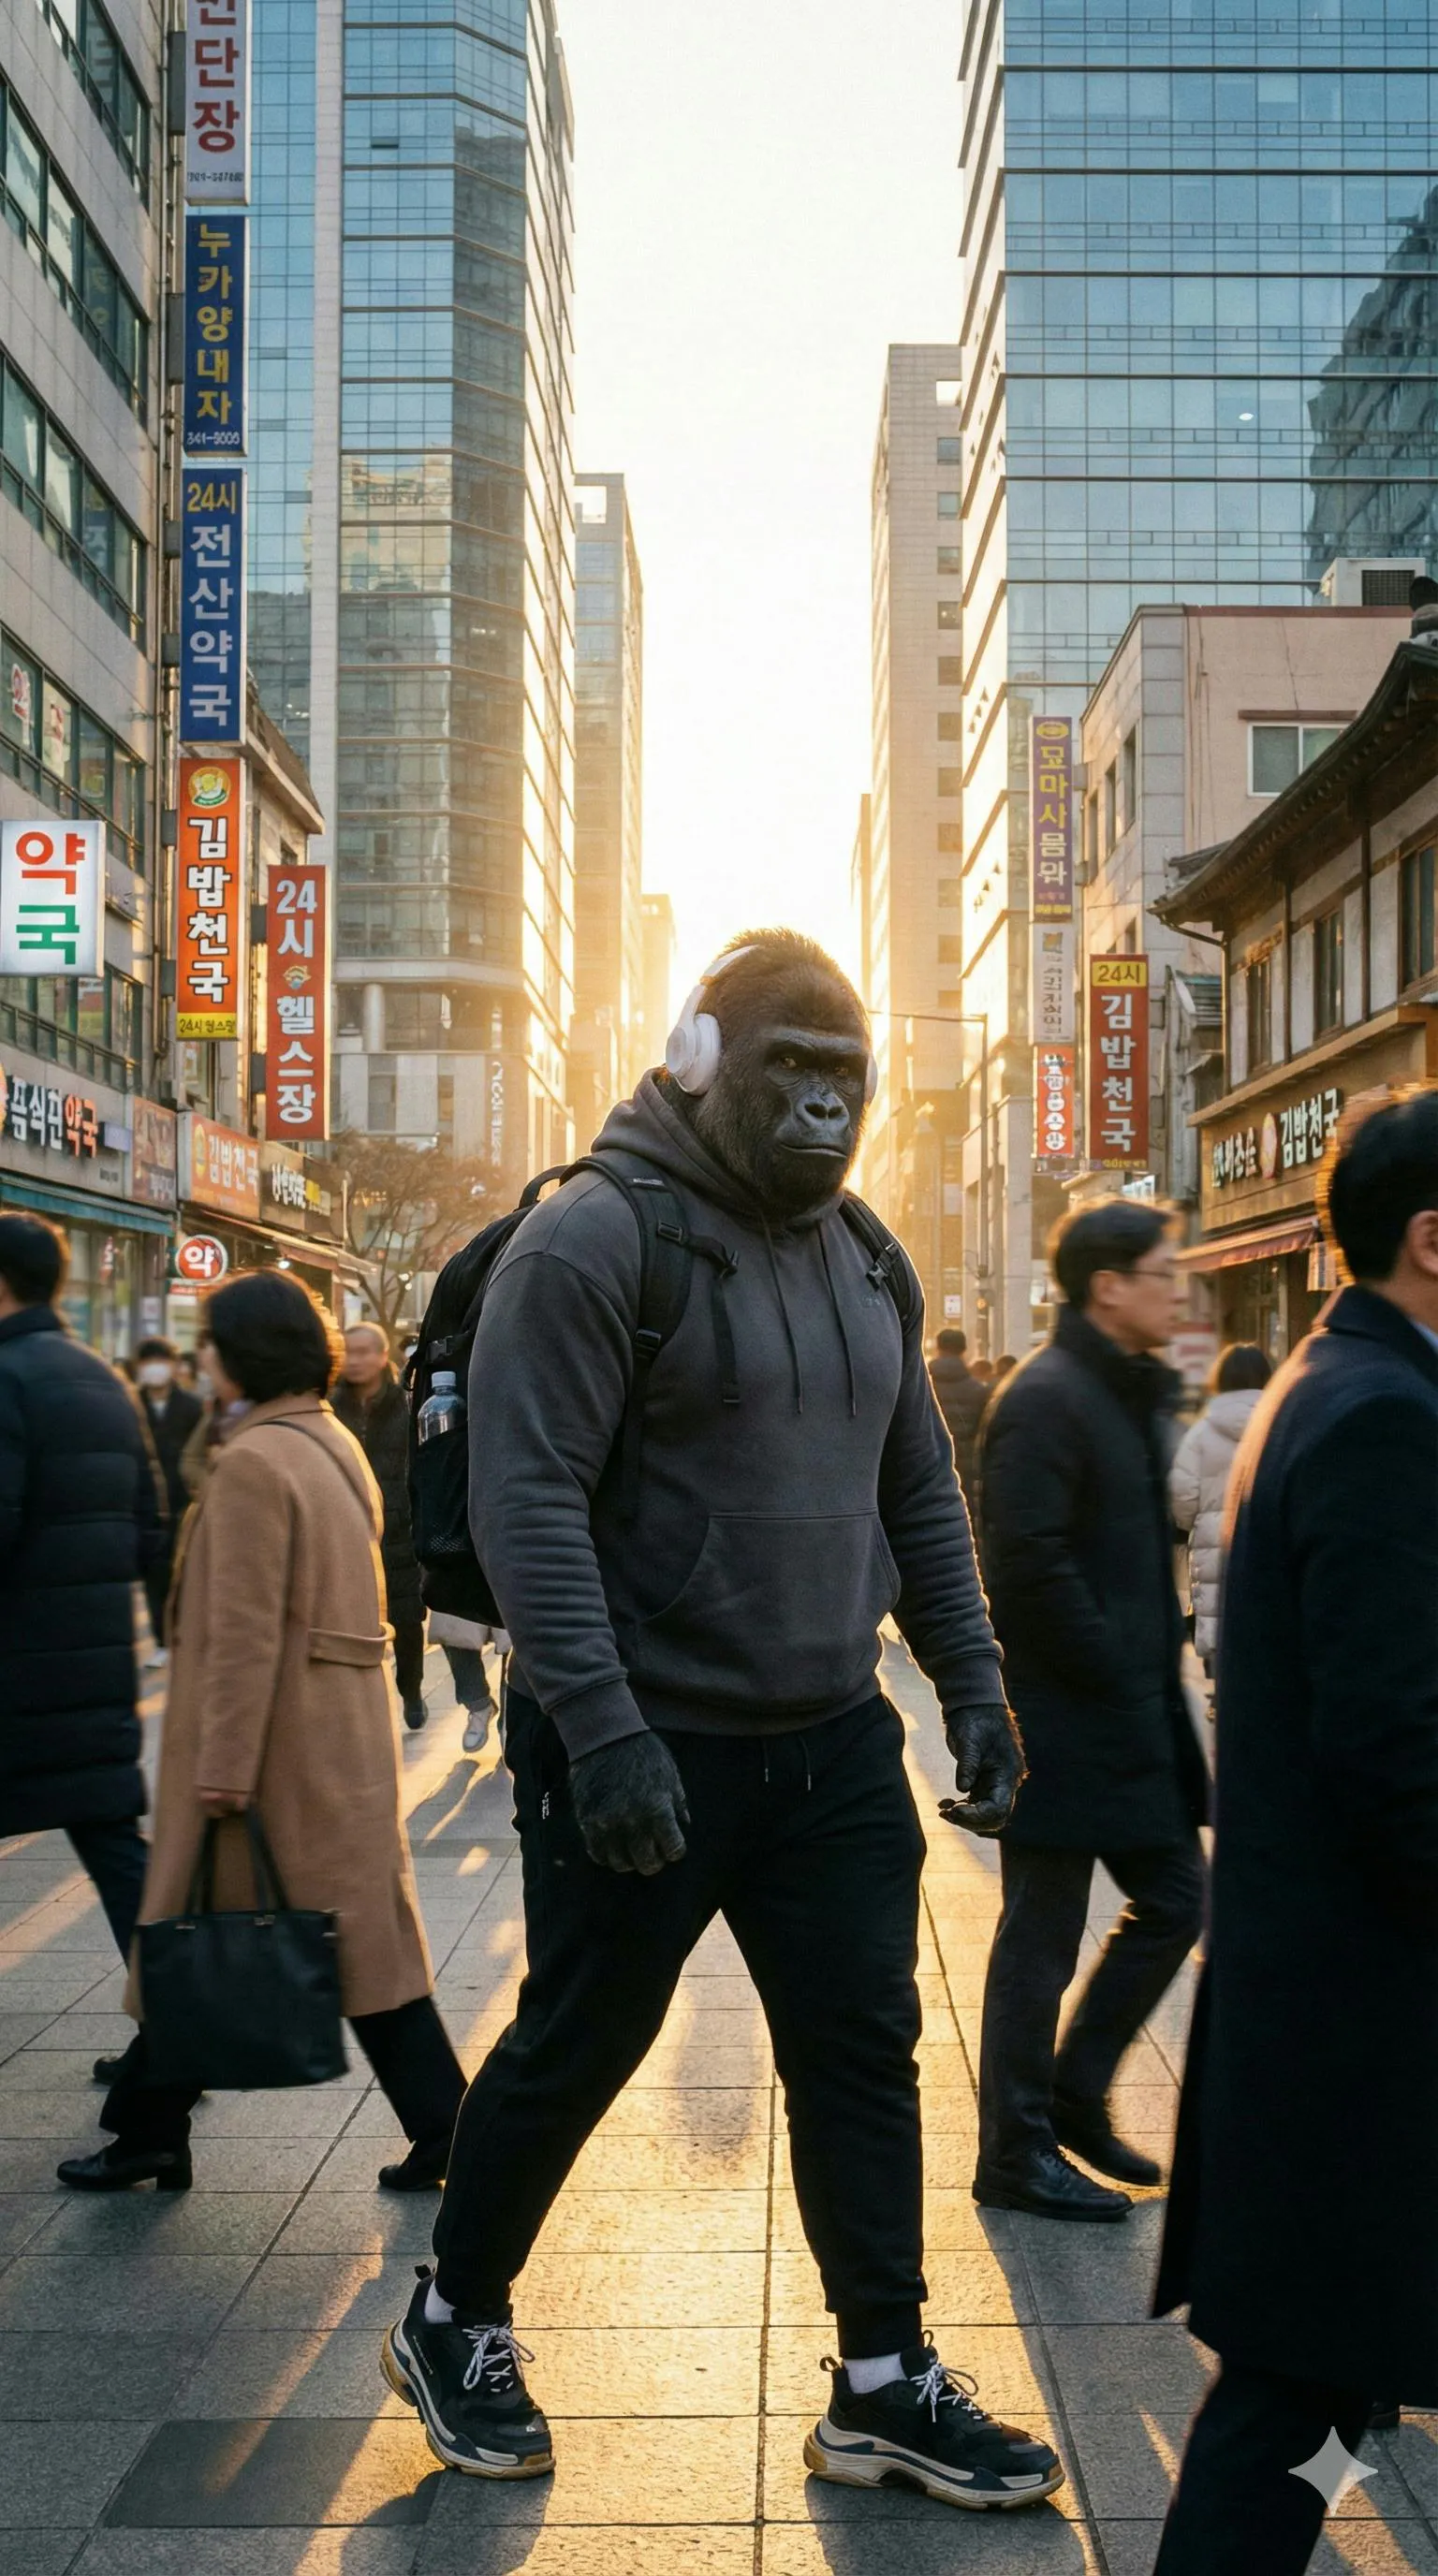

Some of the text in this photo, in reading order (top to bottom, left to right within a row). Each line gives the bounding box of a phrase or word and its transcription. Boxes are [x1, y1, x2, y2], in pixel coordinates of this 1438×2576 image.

[187, 480, 237, 514] 24시
[189, 524, 234, 726] 전산약국
[15, 830, 86, 966] 약국
[187, 815, 232, 1004] 김밥천국
[1097, 965, 1140, 985] 24시
[276, 995, 316, 1124] 헬스장
[1100, 993, 1137, 1153] 김밥천국
[184, 1244, 215, 1278] 약
